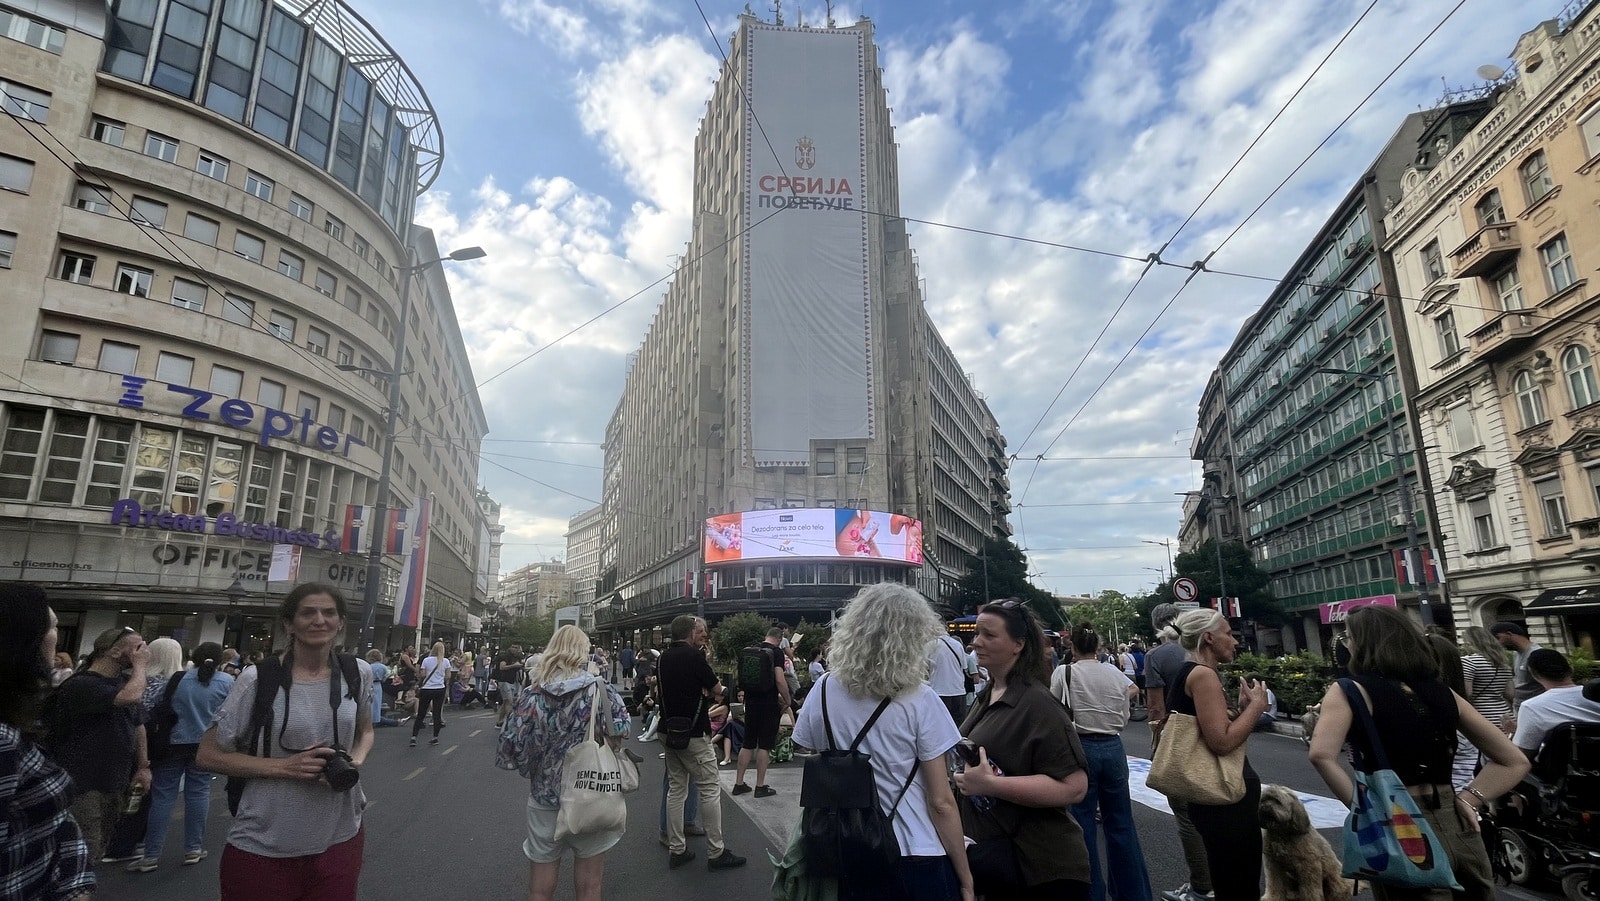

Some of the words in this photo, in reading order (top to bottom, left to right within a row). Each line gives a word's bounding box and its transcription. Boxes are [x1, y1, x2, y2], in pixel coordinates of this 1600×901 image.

[1458, 156, 1507, 201] ЗАДУЖБИНА
[1510, 101, 1567, 157] ДИМИТРИЈА
[758, 175, 853, 195] СРБИЈА
[758, 195, 853, 211] ПОБЕЂУЈЕ
[751, 525, 787, 533] Dezodorans
[12, 560, 92, 570] officeshoes.rs
[152, 543, 270, 572] OFFICE
